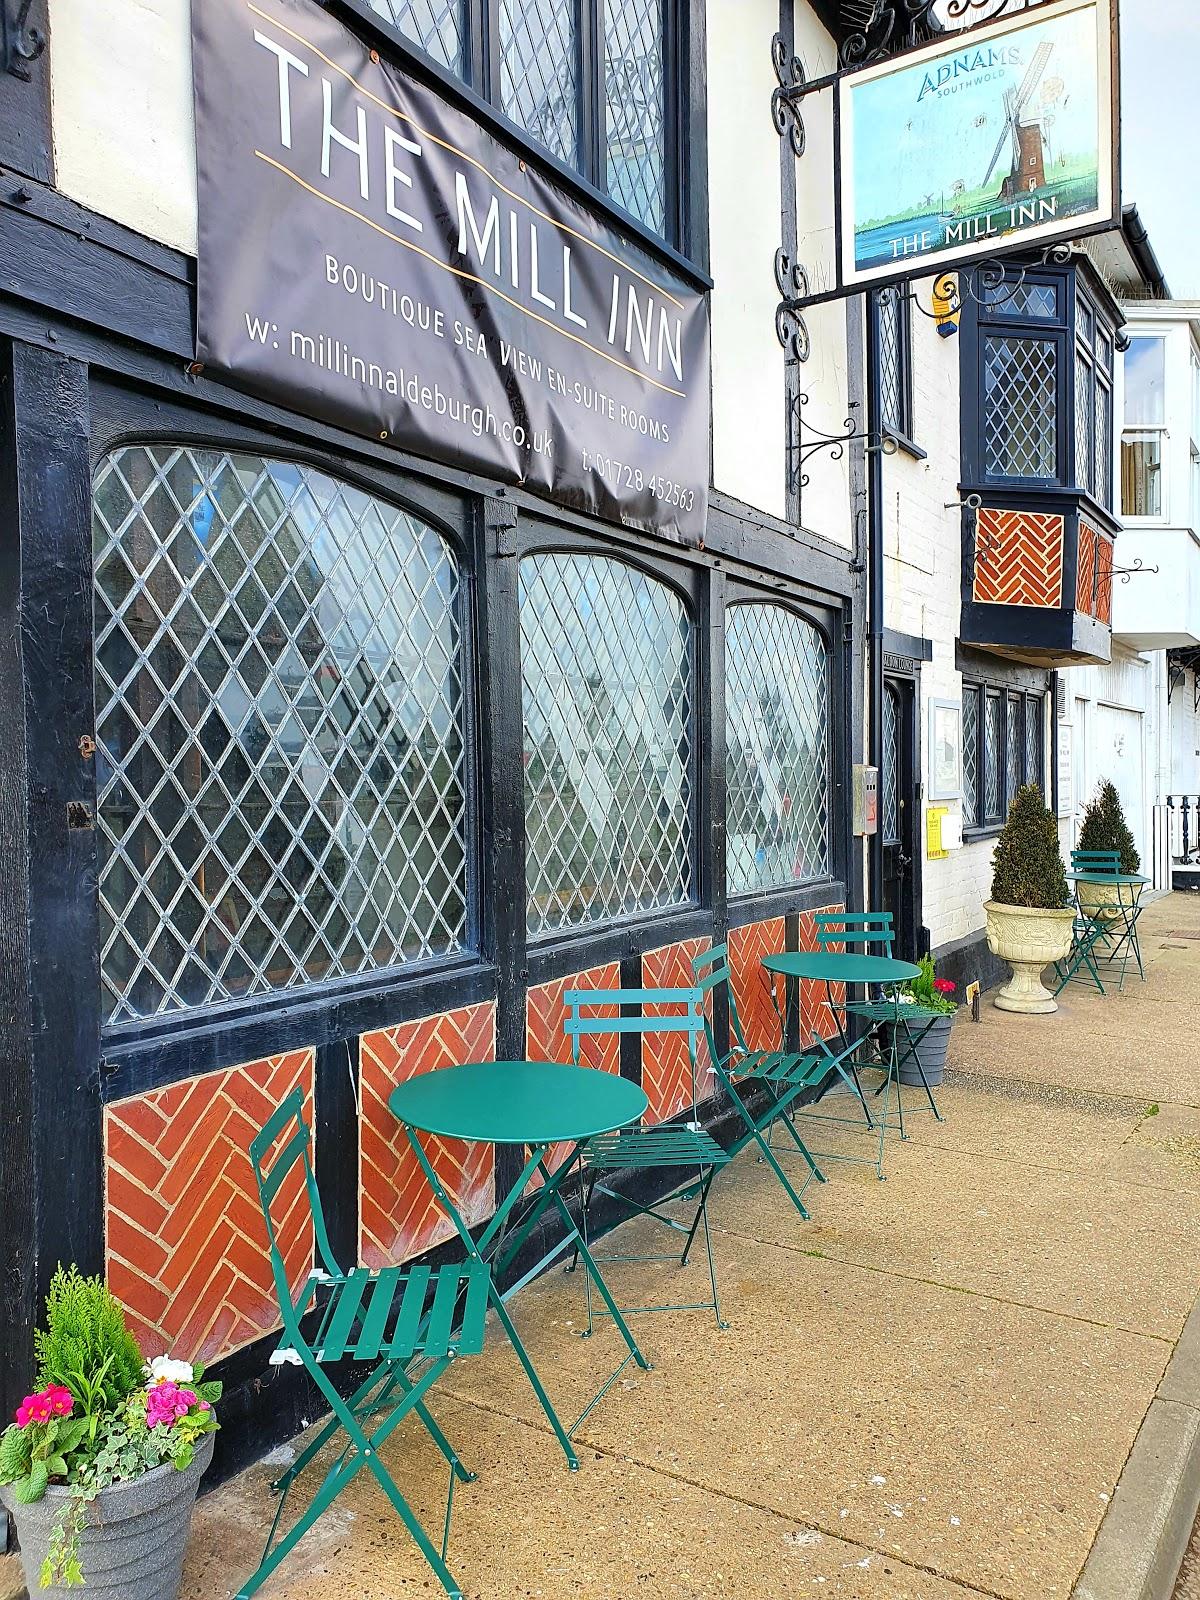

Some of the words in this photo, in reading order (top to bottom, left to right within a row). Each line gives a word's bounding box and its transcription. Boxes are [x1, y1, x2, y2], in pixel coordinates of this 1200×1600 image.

[937, 69, 1005, 99] SOUTHWOLD
[253, 28, 423, 233] THE
[455, 171, 587, 329] MILL
[607, 274, 683, 382] INN
[888, 231, 932, 258] THE
[944, 214, 998, 245] MILL
[1009, 196, 1057, 228] INN
[290, 329, 553, 458] millinnaldeburgh.co.uk
[325, 254, 444, 337] BOUTIQUE
[453, 320, 488, 359] SEA
[499, 340, 542, 382] VIEW
[547, 367, 616, 420] EN-SUITE
[620, 404, 670, 443] ROOMS
[581, 446, 593, 472] t:
[596, 453, 644, 492] 01728
[648, 475, 695, 512] 452563
